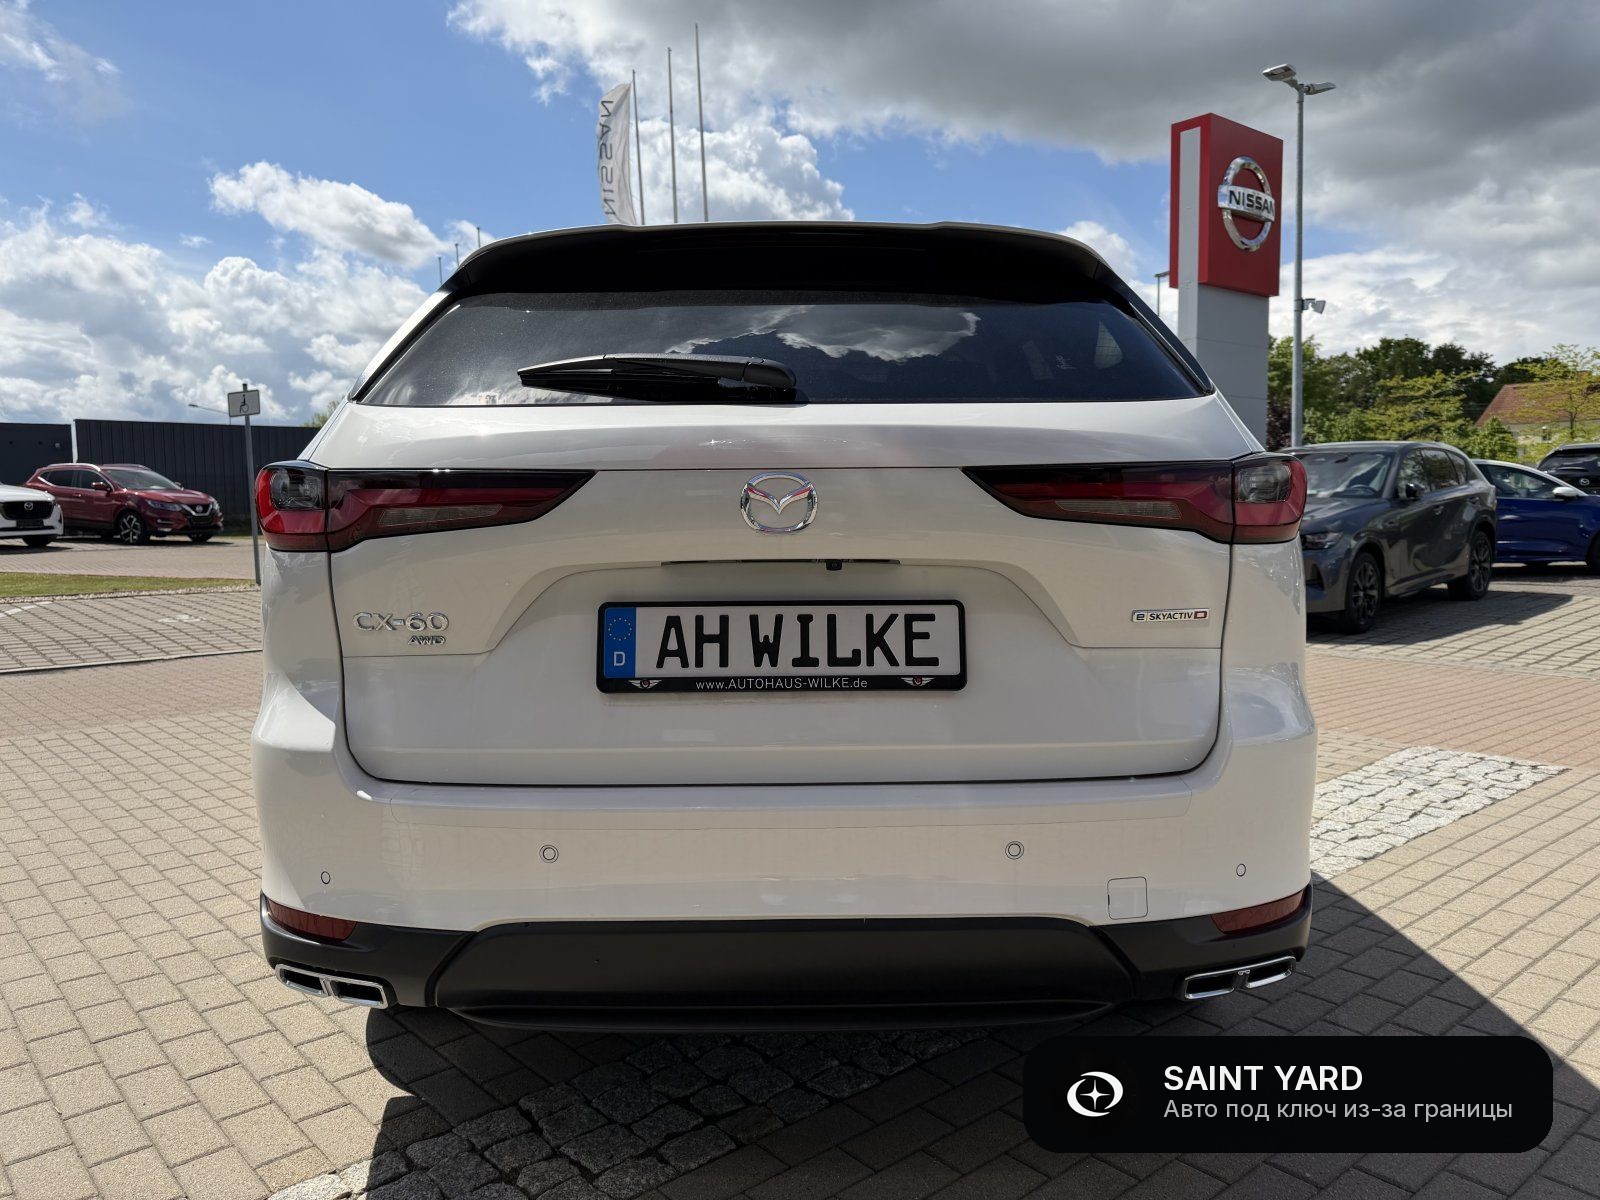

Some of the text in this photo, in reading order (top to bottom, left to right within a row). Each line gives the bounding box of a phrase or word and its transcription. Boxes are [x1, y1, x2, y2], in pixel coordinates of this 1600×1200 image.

[1229, 190, 1274, 214] NISSAN
[353, 611, 450, 631] CX-60
[407, 635, 446, 645] AWD
[656, 613, 940, 669] AH WILKE
[613, 651, 626, 667] D
[695, 677, 868, 690] www.AUTOHAUS-WILKE.de
